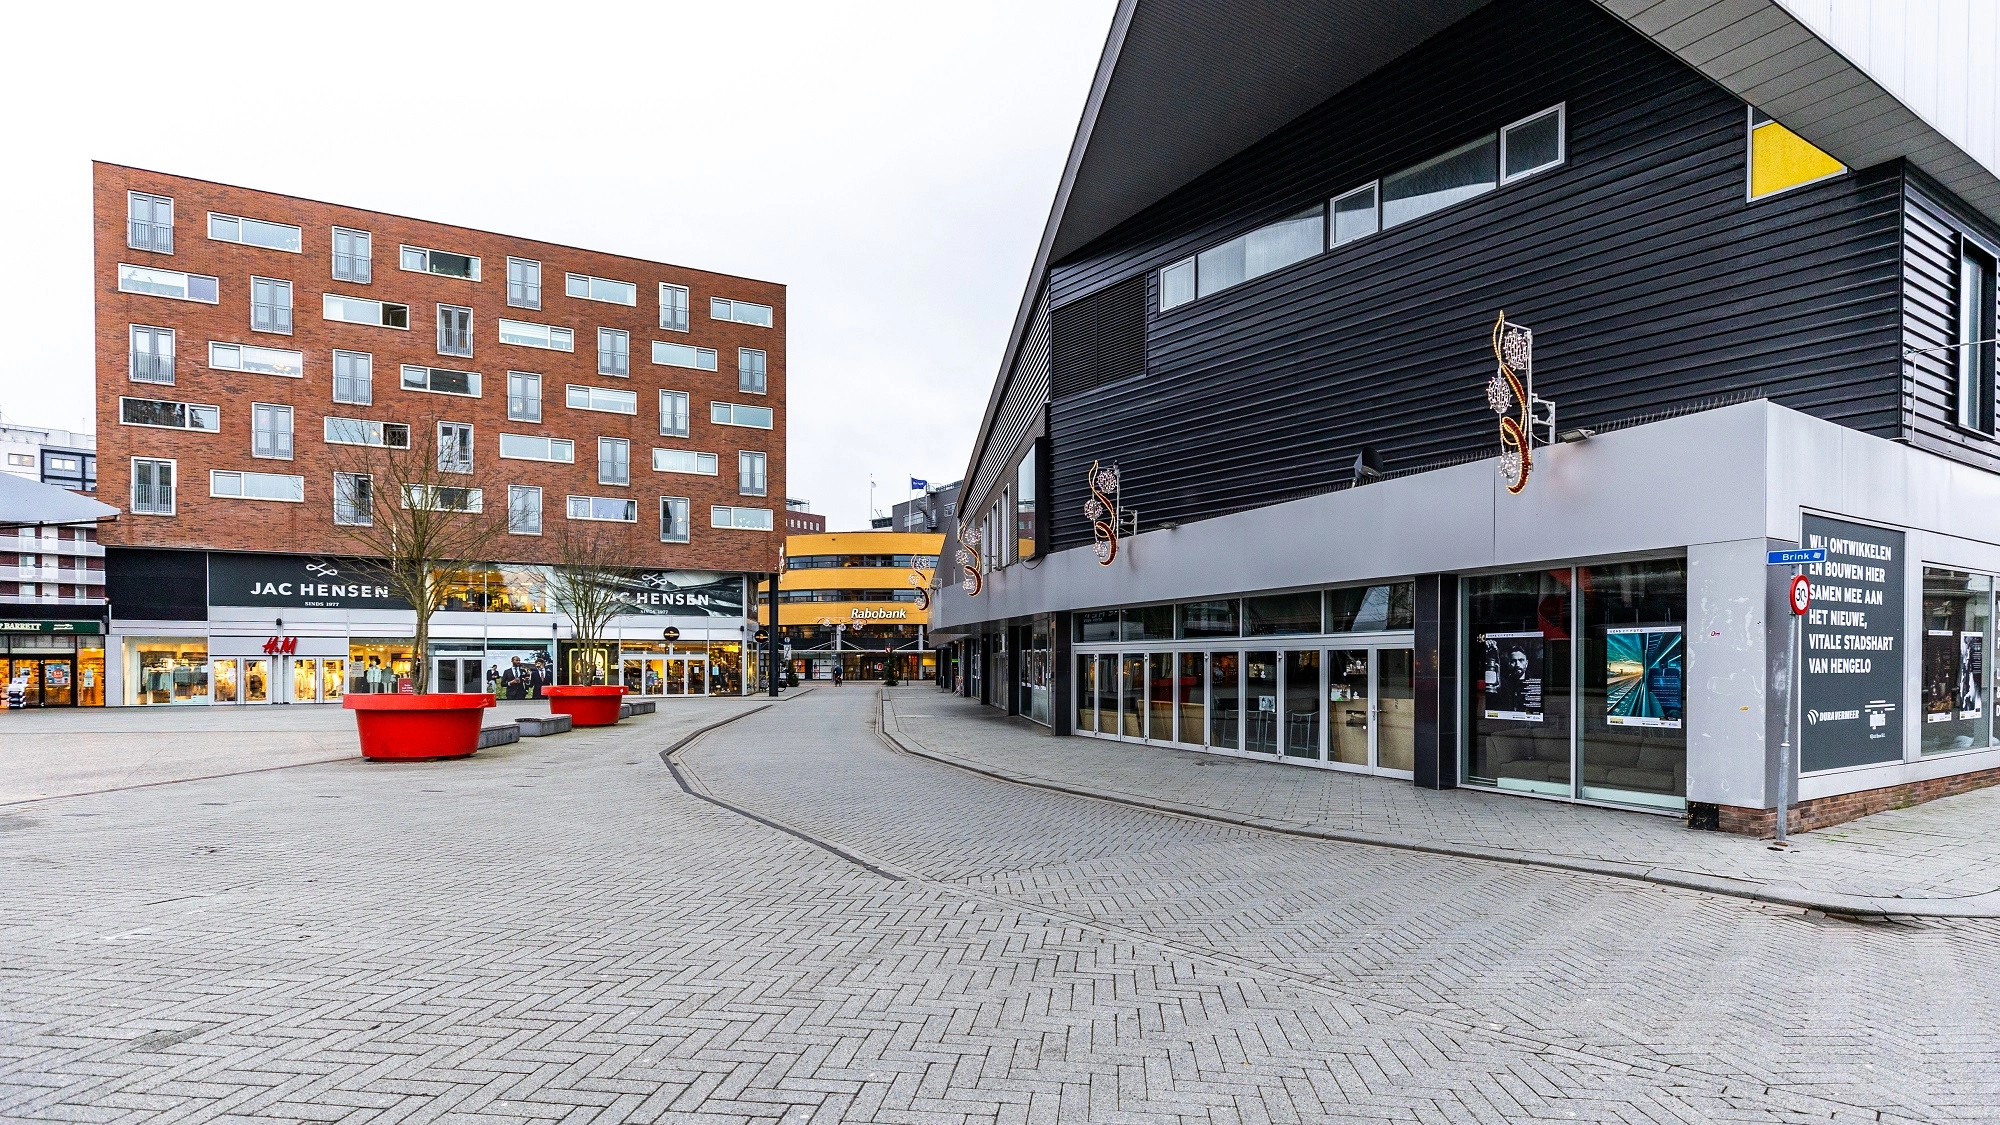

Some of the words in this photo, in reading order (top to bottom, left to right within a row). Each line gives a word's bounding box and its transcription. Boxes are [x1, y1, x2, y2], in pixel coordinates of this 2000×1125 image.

[1782, 553, 1810, 561] Brink
[1830, 538, 1892, 561] ONTWIKKELEN
[1809, 562, 1823, 576] EN
[1825, 562, 1864, 580] BOUWEN
[1865, 566, 1886, 583] HIER
[250, 582, 292, 595] JAC
[300, 583, 389, 598] HENSEN
[1809, 584, 1842, 602] SAMEN
[1844, 587, 1863, 604] MEE
[1864, 590, 1883, 605] AAN
[636, 592, 709, 606] HENSEN
[851, 607, 907, 619] Rabobank
[1808, 609, 1828, 625] HET
[1830, 610, 1868, 629] NIEUWE,
[2, 622, 41, 631] BARRETT
[262, 636, 298, 655] H&M
[1808, 634, 1842, 650] VITALE
[1844, 635, 1894, 651] STADSHART
[1808, 658, 1828, 674] VAN
[1830, 658, 1871, 674] HENGELO
